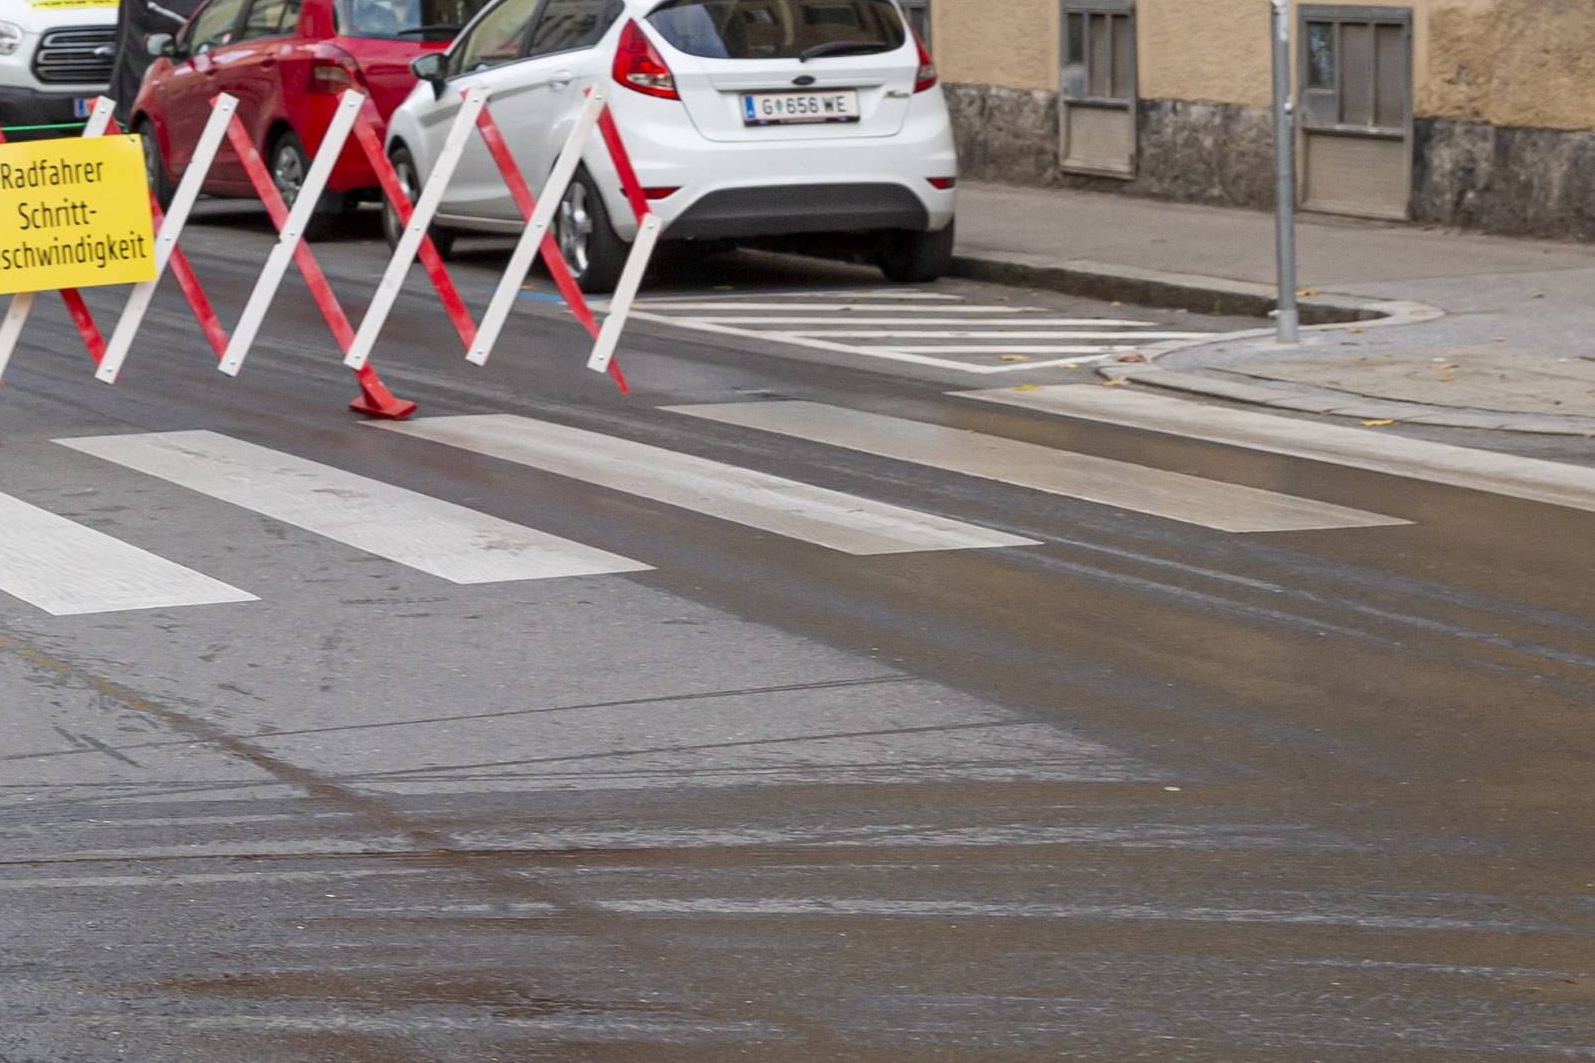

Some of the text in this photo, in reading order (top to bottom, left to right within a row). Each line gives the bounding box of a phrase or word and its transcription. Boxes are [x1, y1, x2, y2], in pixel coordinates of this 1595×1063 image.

[762, 98, 774, 115] G
[0, 157, 104, 190] Radfahrer
[17, 197, 98, 231] Schritt-
